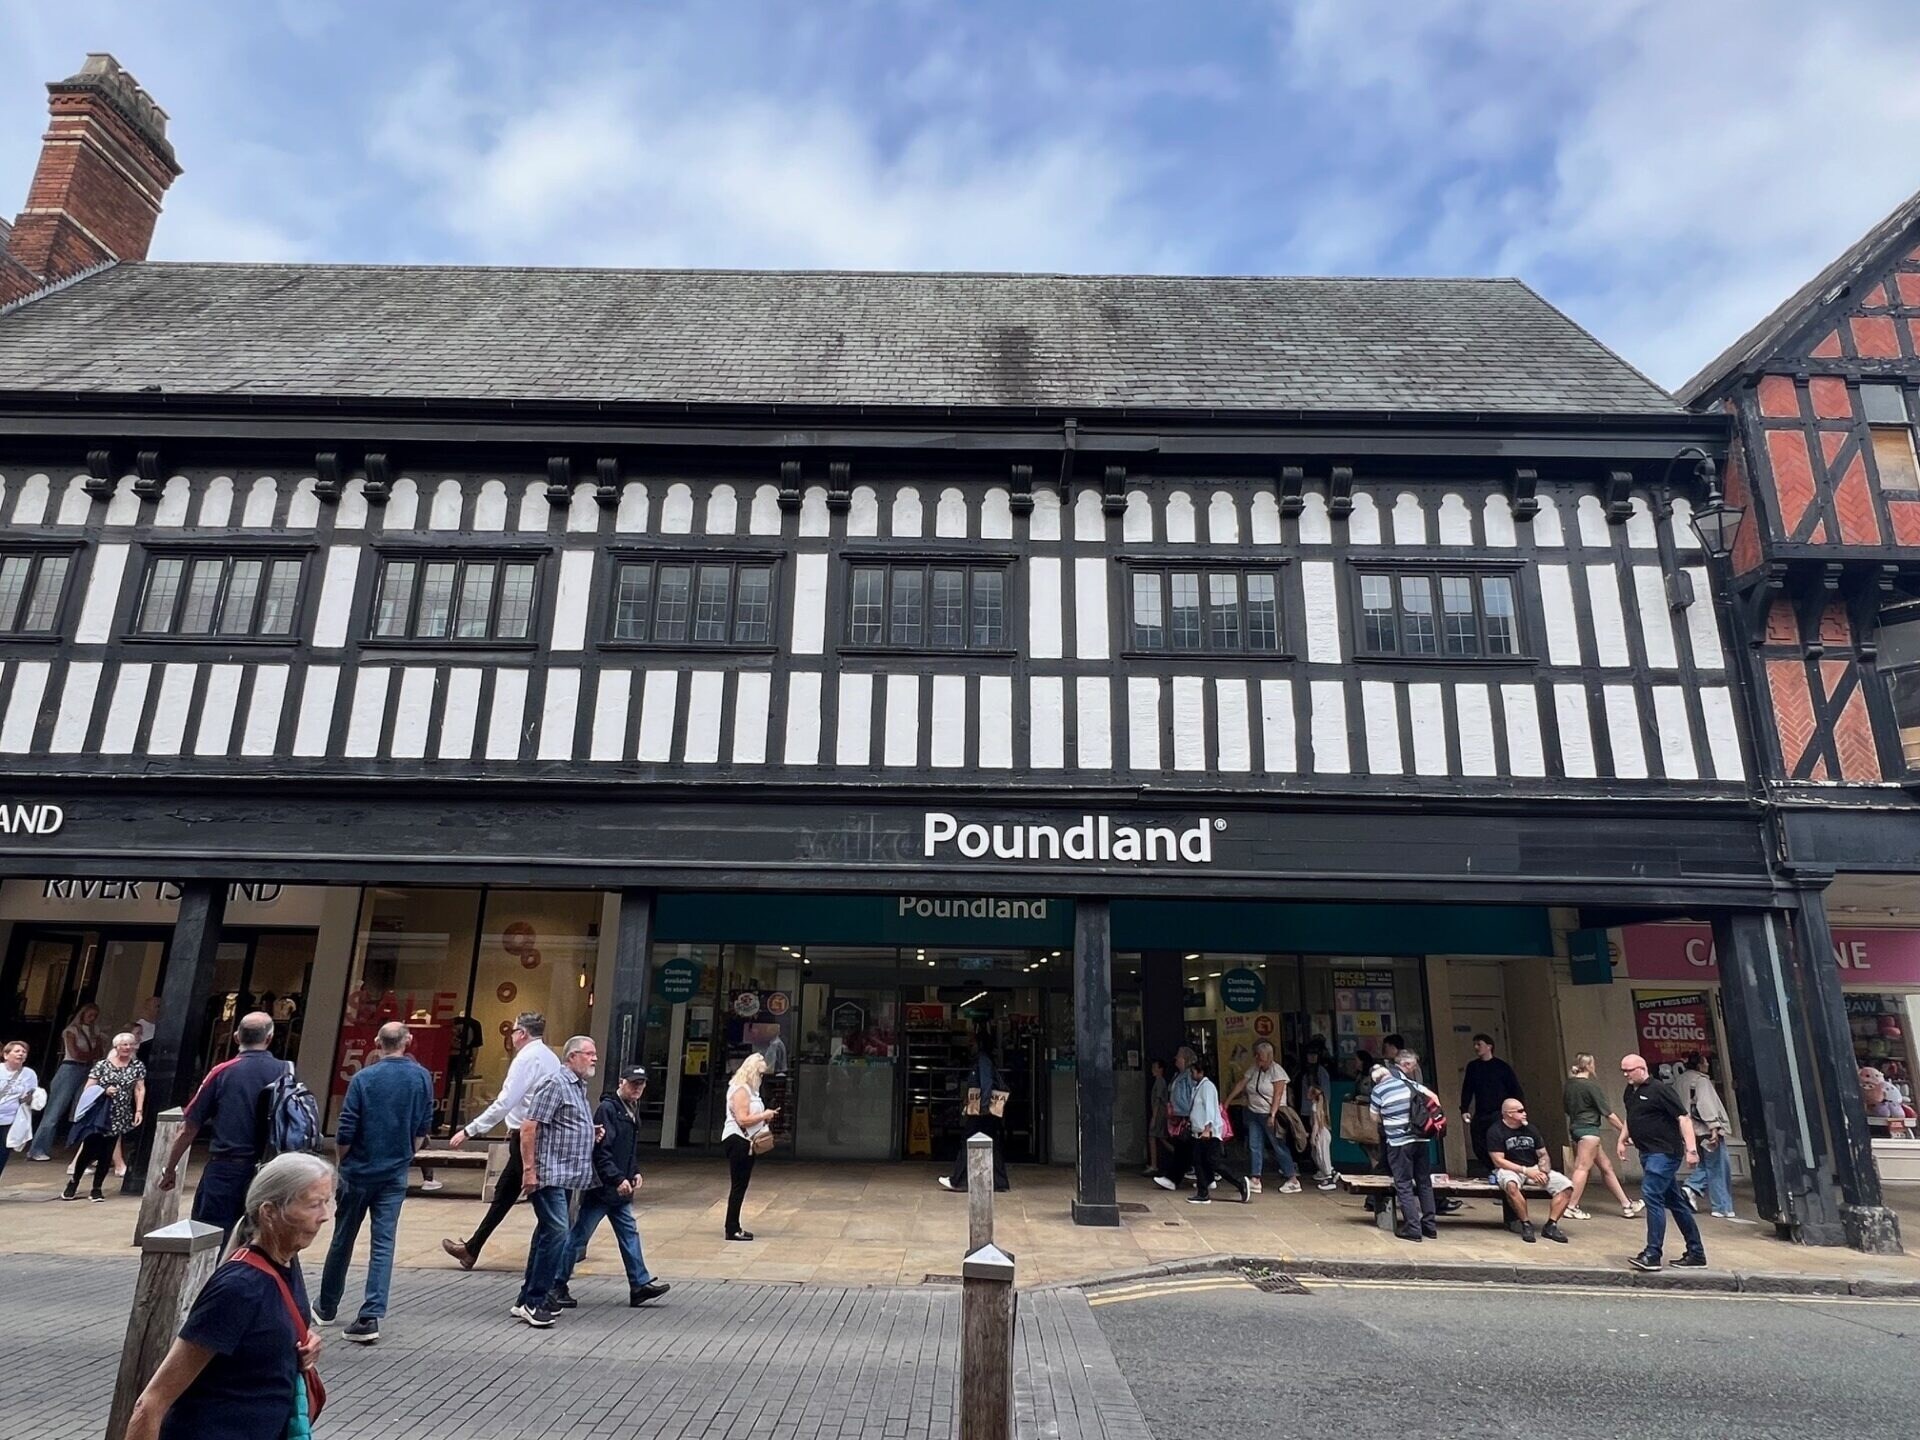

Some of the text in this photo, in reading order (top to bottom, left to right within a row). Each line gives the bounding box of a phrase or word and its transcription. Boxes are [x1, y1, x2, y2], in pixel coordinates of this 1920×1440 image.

[42, 880, 283, 902] RIVER ISND
[898, 897, 1047, 920] Poundland
[664, 968, 692, 977] Clothing
[1226, 977, 1255, 986] Clothing
[1647, 1012, 1697, 1027] STORE
[1642, 1026, 1706, 1040] CLOSING
